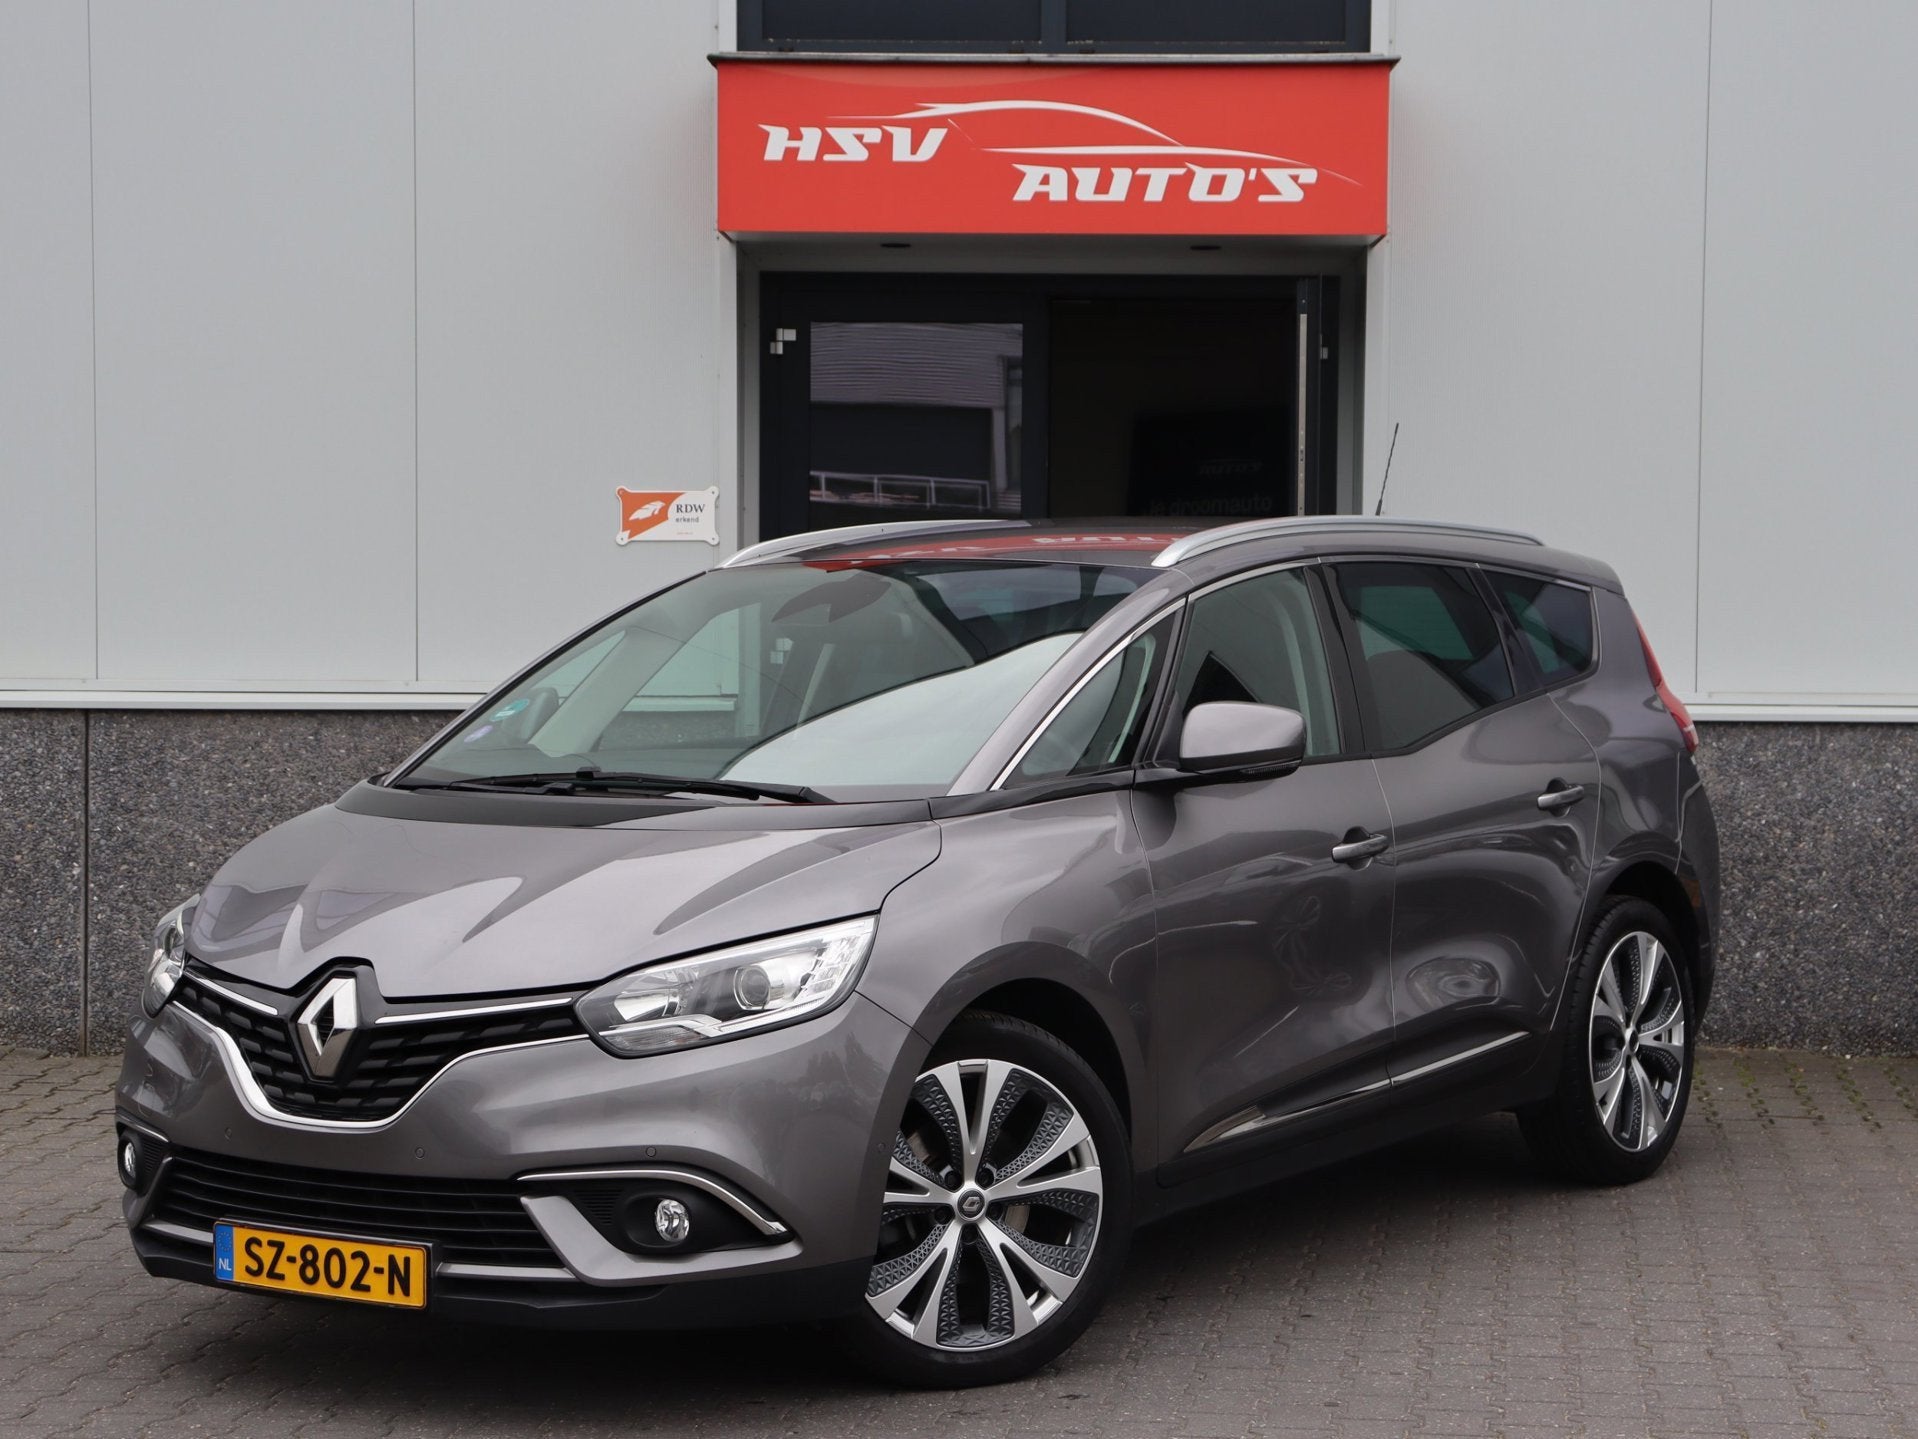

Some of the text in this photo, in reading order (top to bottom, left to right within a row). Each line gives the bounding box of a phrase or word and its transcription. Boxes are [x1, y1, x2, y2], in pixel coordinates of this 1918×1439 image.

[759, 124, 947, 161] HSV
[1013, 162, 1317, 202] AUTO'S
[676, 504, 705, 513] RDW
[218, 1257, 232, 1271] NL
[244, 1236, 411, 1297] SZ-802-N
